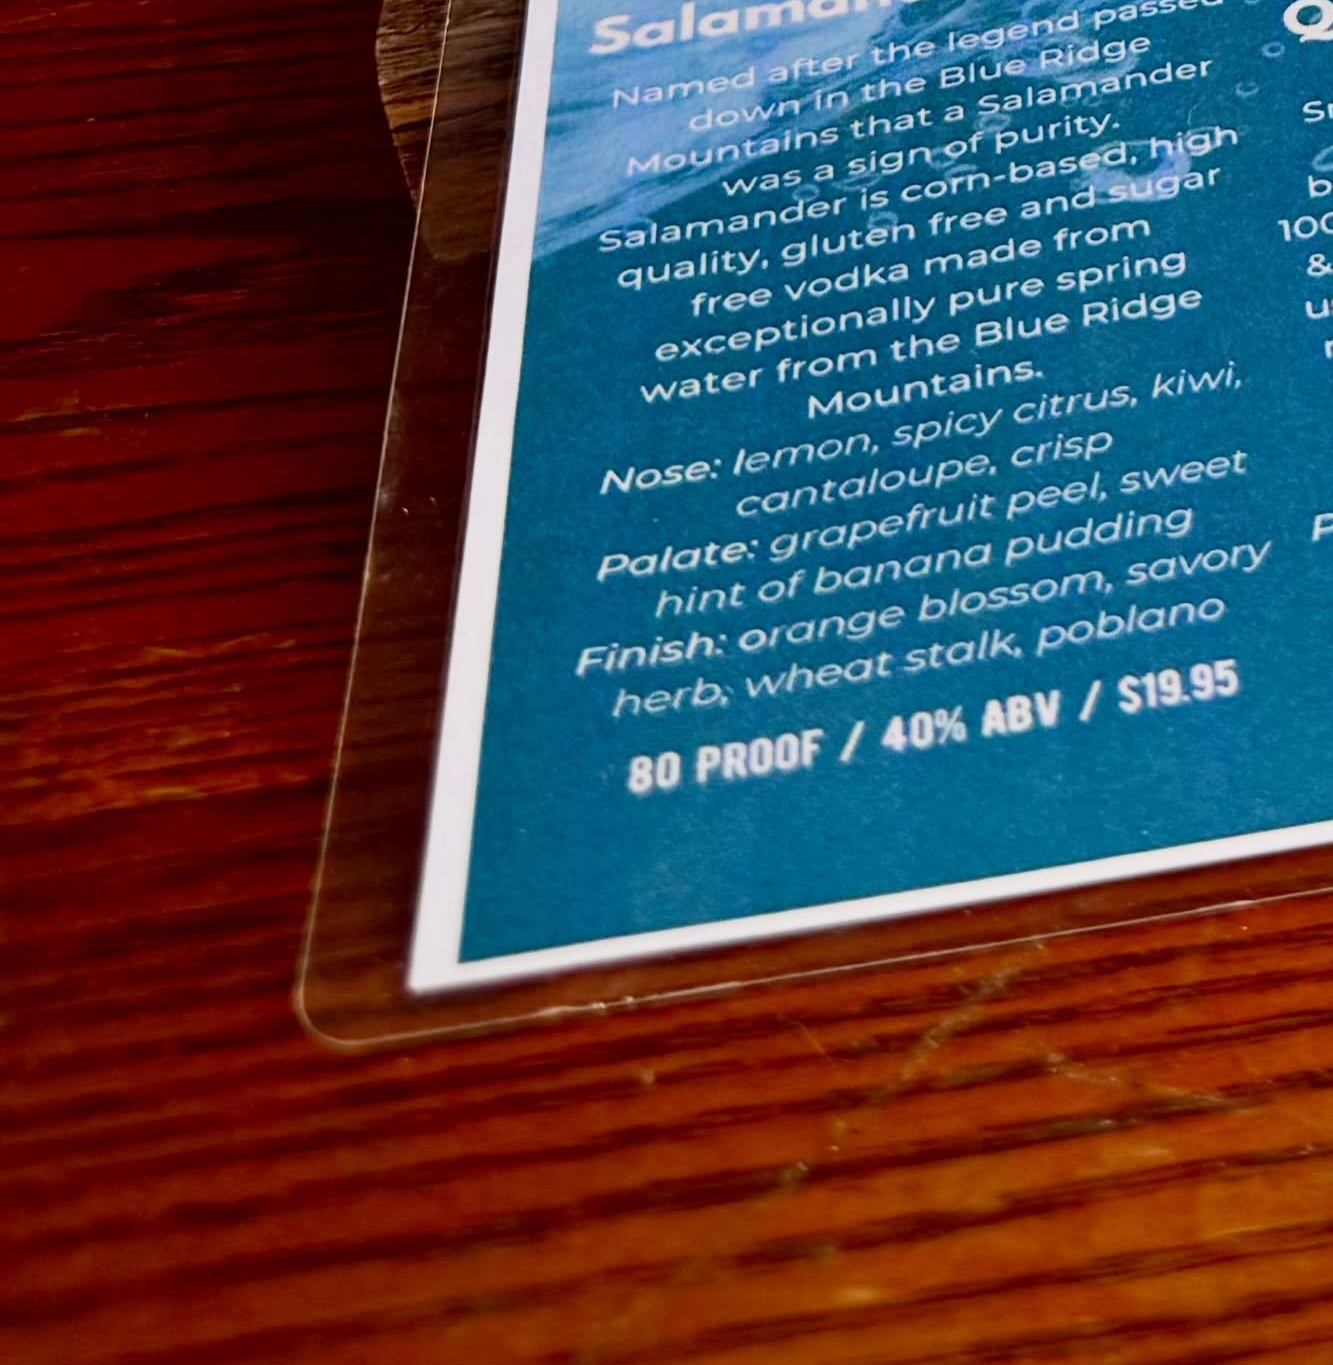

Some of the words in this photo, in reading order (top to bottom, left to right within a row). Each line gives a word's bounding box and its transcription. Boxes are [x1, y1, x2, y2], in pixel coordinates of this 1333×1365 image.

[612, 66, 756, 108] Named
[770, 52, 858, 82] after
[870, 39, 936, 66] the
[947, 8, 1081, 53] legend
[599, 457, 722, 495] Nose:
[732, 431, 880, 476] lemon,
[892, 406, 1004, 449] spicy
[1012, 383, 1139, 425] citrus,
[1151, 358, 1242, 400] kiwi,
[626, 748, 683, 796] 80
[694, 726, 825, 785] PROOF
[880, 704, 968, 753] 40%
[980, 687, 1062, 738] ABV
[1116, 656, 1241, 715] $19.95
